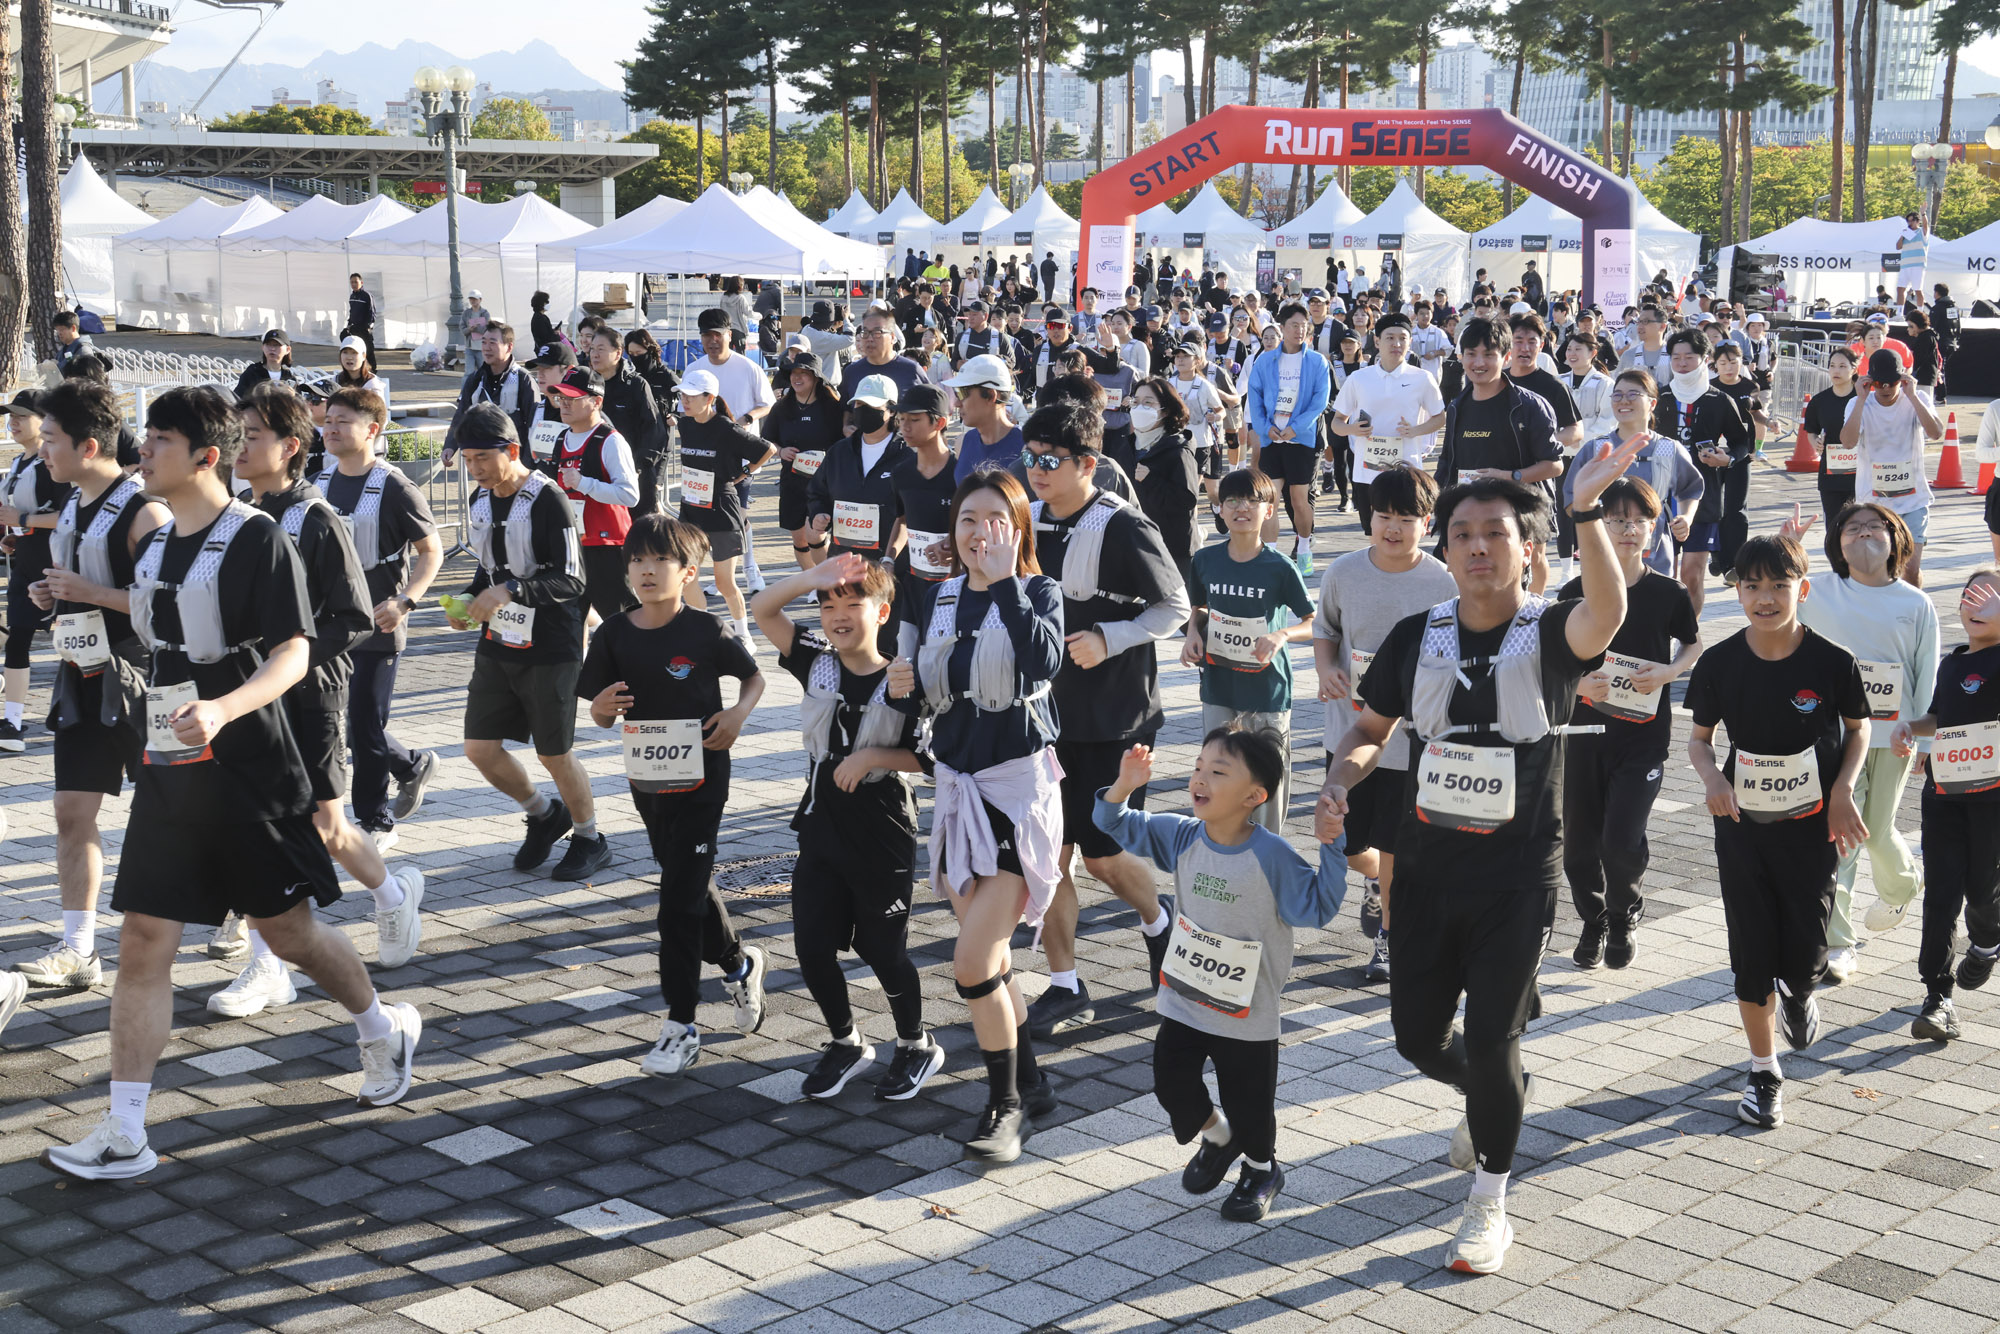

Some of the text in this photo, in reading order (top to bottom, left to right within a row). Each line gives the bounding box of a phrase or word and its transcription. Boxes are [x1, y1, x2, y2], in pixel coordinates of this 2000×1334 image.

[1264, 119, 1344, 156] Run
[1129, 131, 1221, 197] START
[1506, 133, 1603, 201] FINISH
[1804, 256, 1852, 269] ROOM
[1967, 257, 1996, 271] MC
[1277, 396, 1293, 404] 208
[541, 433, 556, 444] 524
[1462, 430, 1492, 439] Nassau
[804, 459, 821, 468] 618
[1884, 472, 1909, 482] 5249
[687, 481, 709, 492] 6256
[845, 517, 873, 529] 6228
[1209, 583, 1266, 599] MILLET
[497, 609, 527, 625] 5048
[64, 633, 98, 650] 5050
[1214, 631, 1221, 641] M
[1351, 652, 1363, 662] Run
[1605, 655, 1615, 664] un
[623, 725, 639, 734] Run
[632, 744, 693, 761] M 5007
[1427, 744, 1443, 757] Run
[1936, 745, 1994, 764] W 6003
[1738, 754, 1754, 767] Run
[1426, 771, 1503, 795] M 5009
[1743, 771, 1810, 792] M 5003
[1194, 872, 1228, 890] SWISS
[1191, 883, 1241, 904] MILITARY
[1178, 916, 1192, 936] Run
[1242, 943, 1258, 951] 5km
[1174, 944, 1188, 960] M
[1188, 951, 1247, 982] 5002
